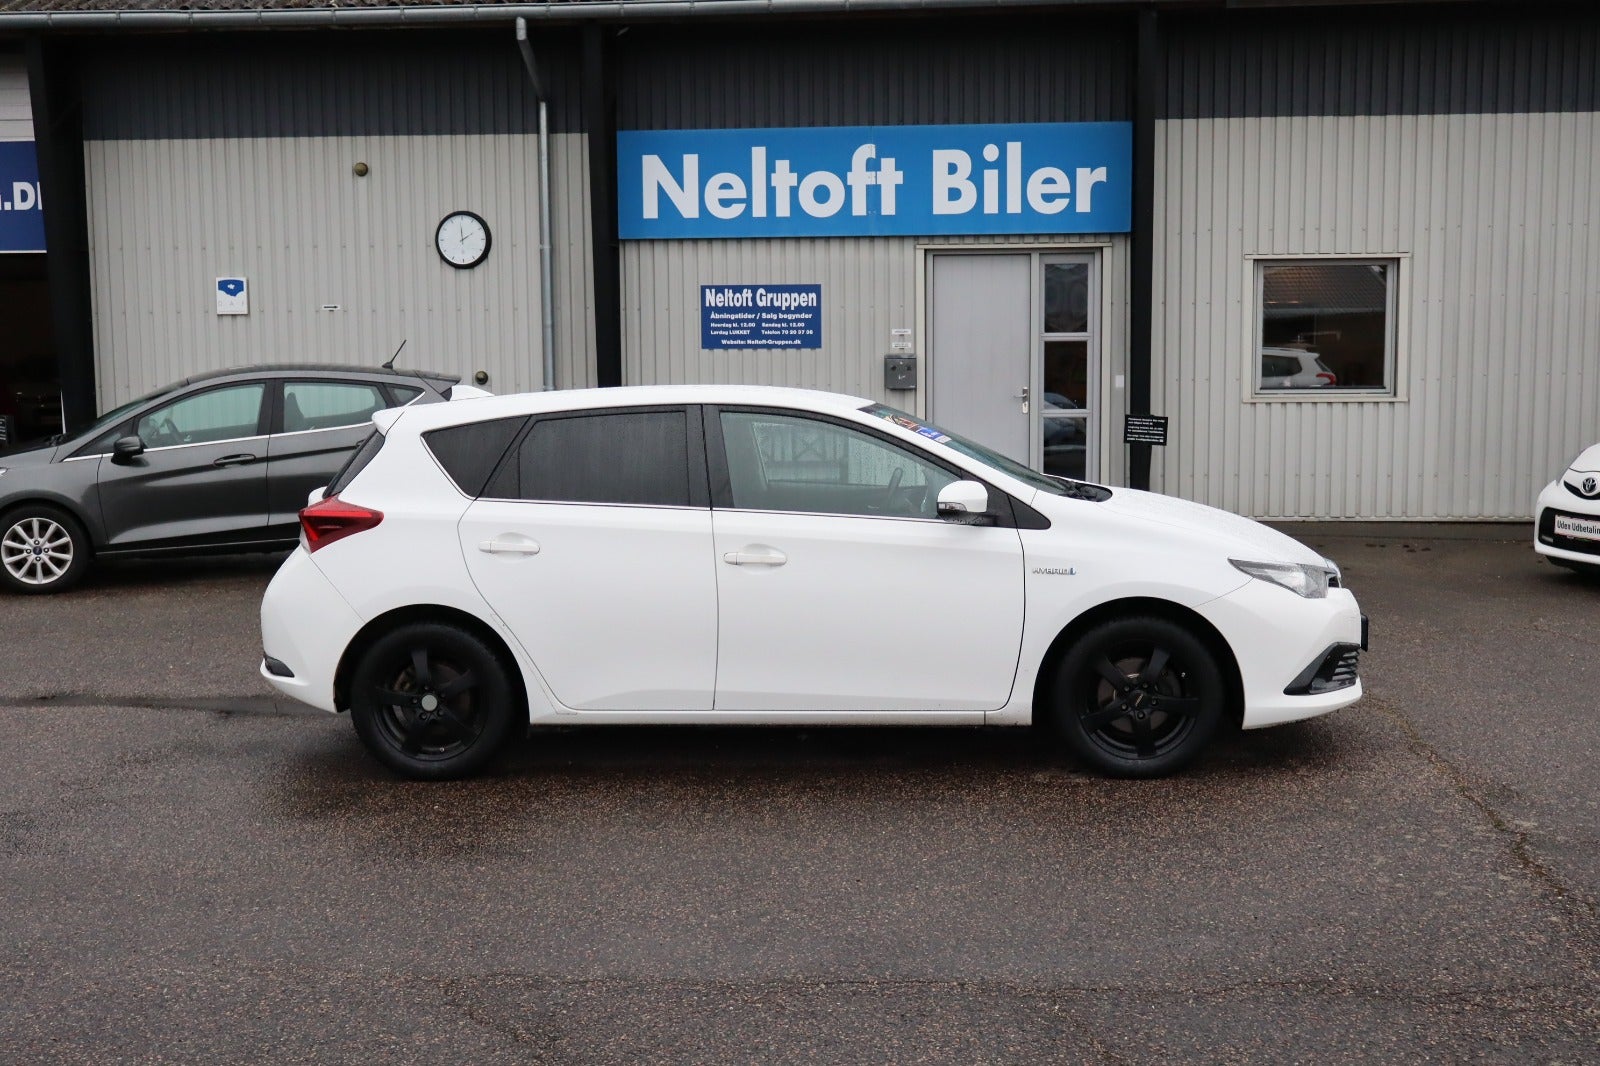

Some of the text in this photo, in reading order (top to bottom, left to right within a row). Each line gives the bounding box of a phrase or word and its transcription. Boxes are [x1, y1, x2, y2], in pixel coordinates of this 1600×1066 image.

[642, 141, 1107, 219] Neltoft Biler
[705, 287, 817, 311] Neltoft Gruppen
[710, 311, 756, 320] Åbningstider
[1557, 519, 1571, 530] Uden
